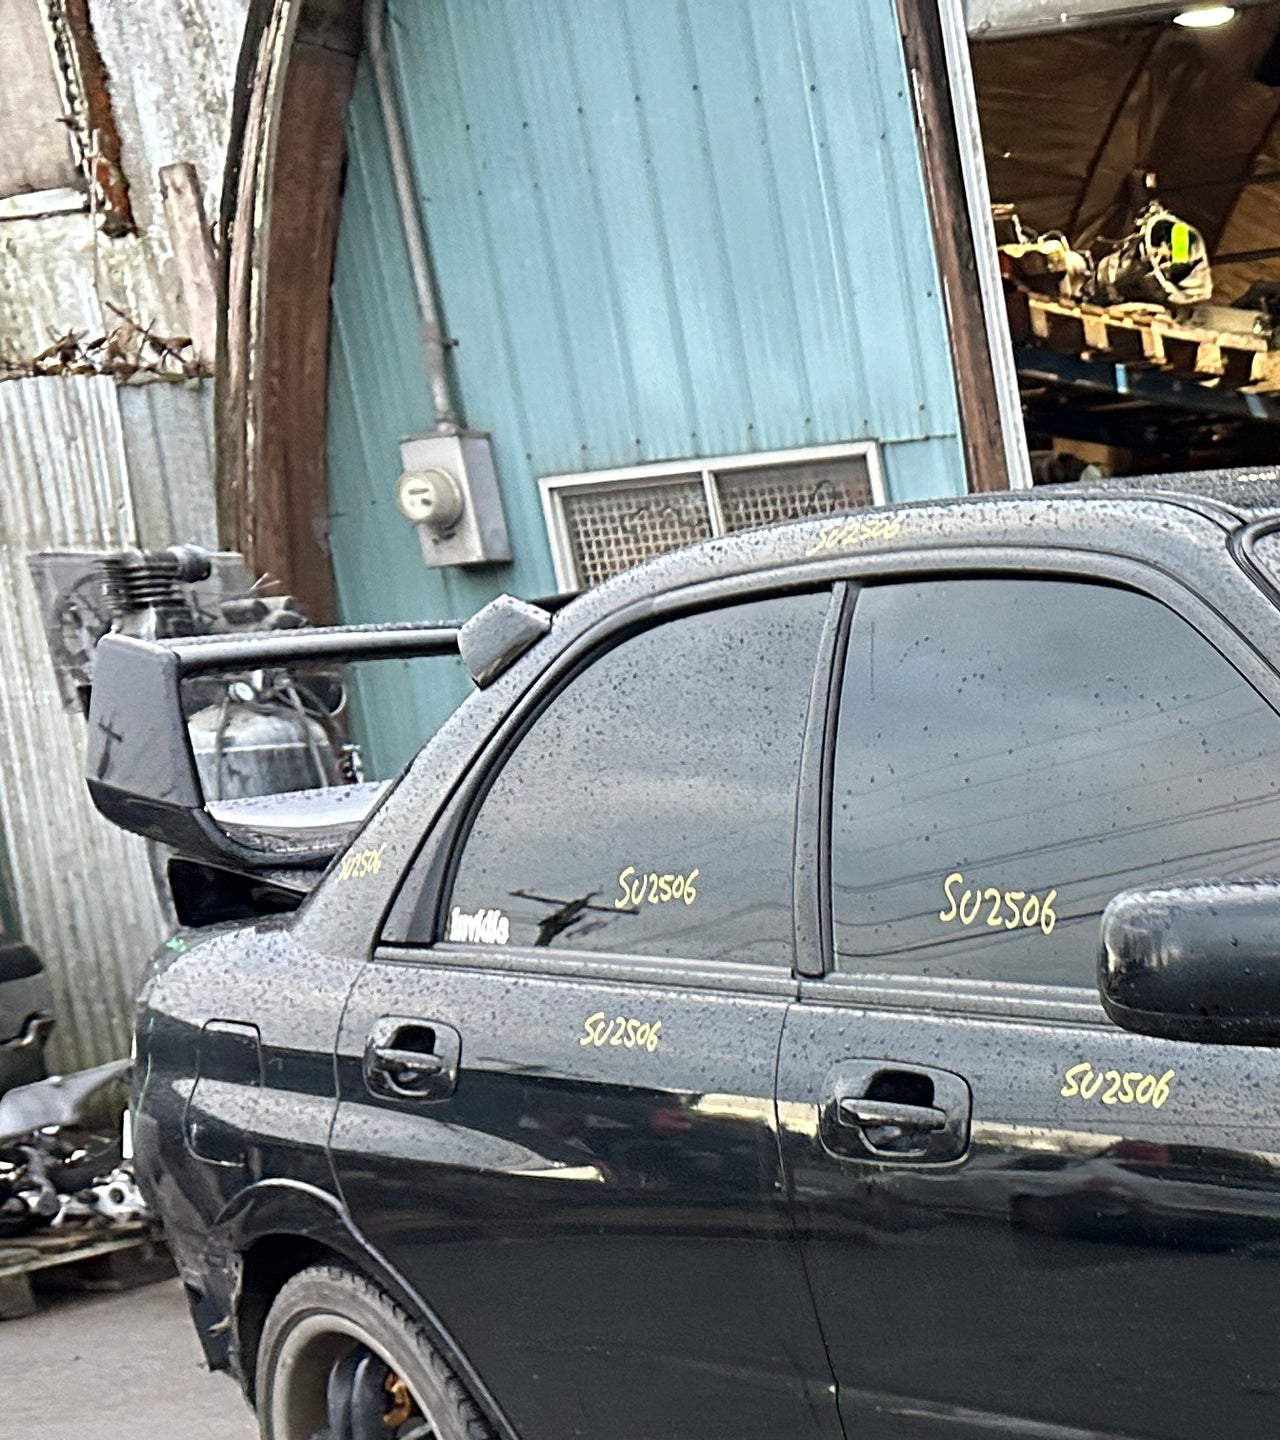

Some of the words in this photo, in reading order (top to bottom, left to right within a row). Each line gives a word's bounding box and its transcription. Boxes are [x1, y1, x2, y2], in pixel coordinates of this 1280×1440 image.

[614, 866, 699, 908] SU2506
[939, 872, 1057, 935] SU2506
[580, 1011, 662, 1053] SU2506
[1060, 1062, 1176, 1109] SU2506
